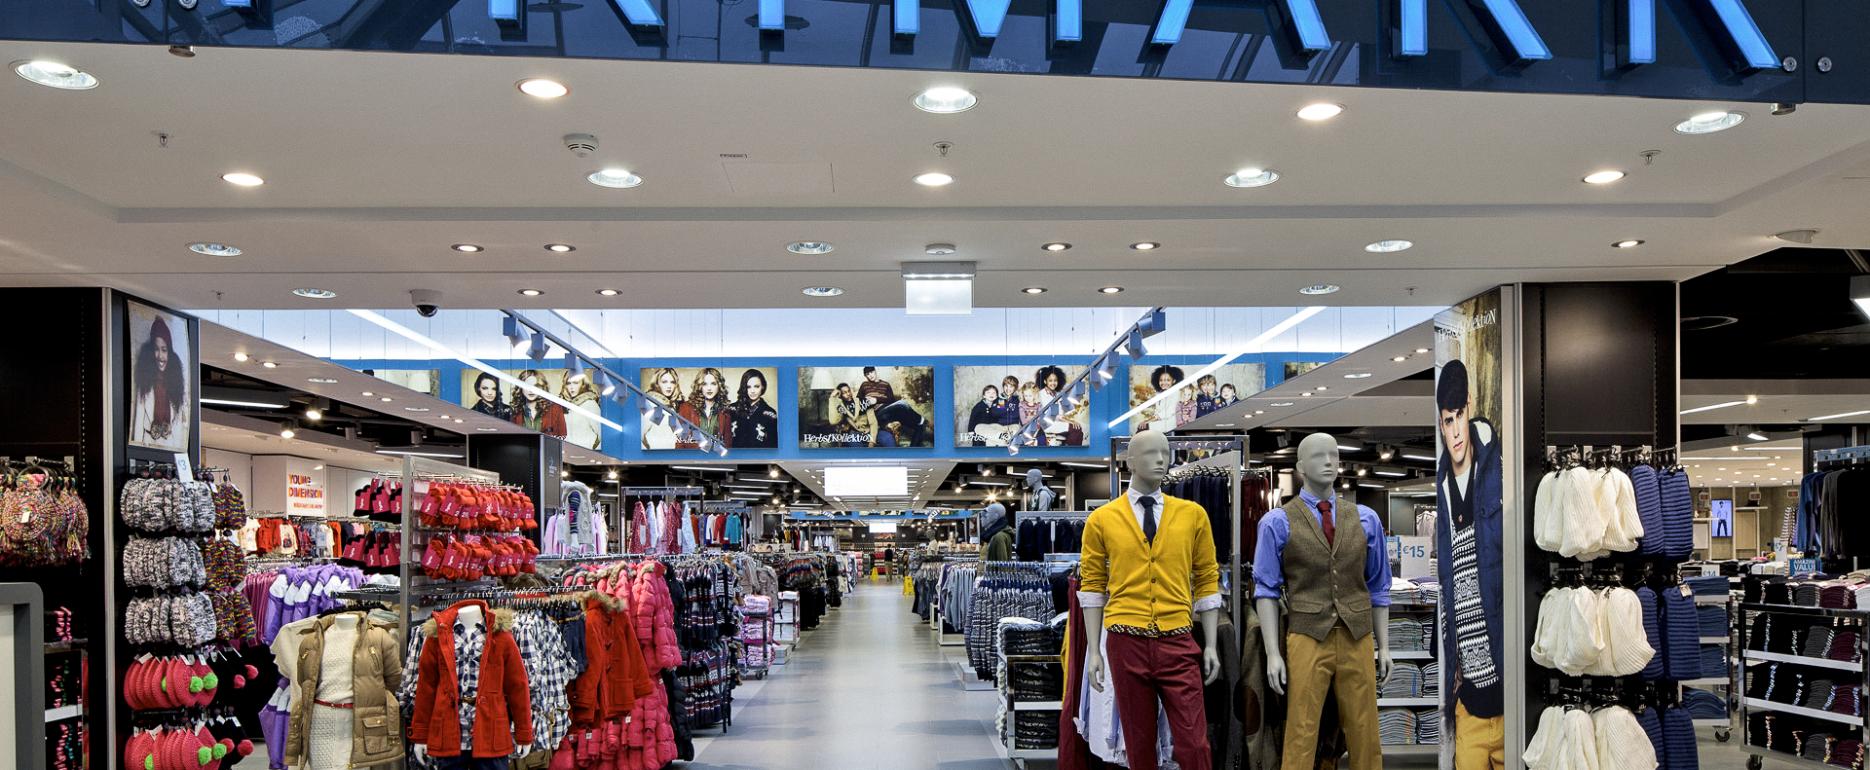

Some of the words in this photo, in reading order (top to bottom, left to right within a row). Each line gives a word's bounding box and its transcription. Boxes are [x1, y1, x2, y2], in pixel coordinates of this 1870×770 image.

[288, 474, 312, 487] YOUNG
[288, 487, 323, 499] DIMENSION
[1402, 545, 1425, 558] €15
